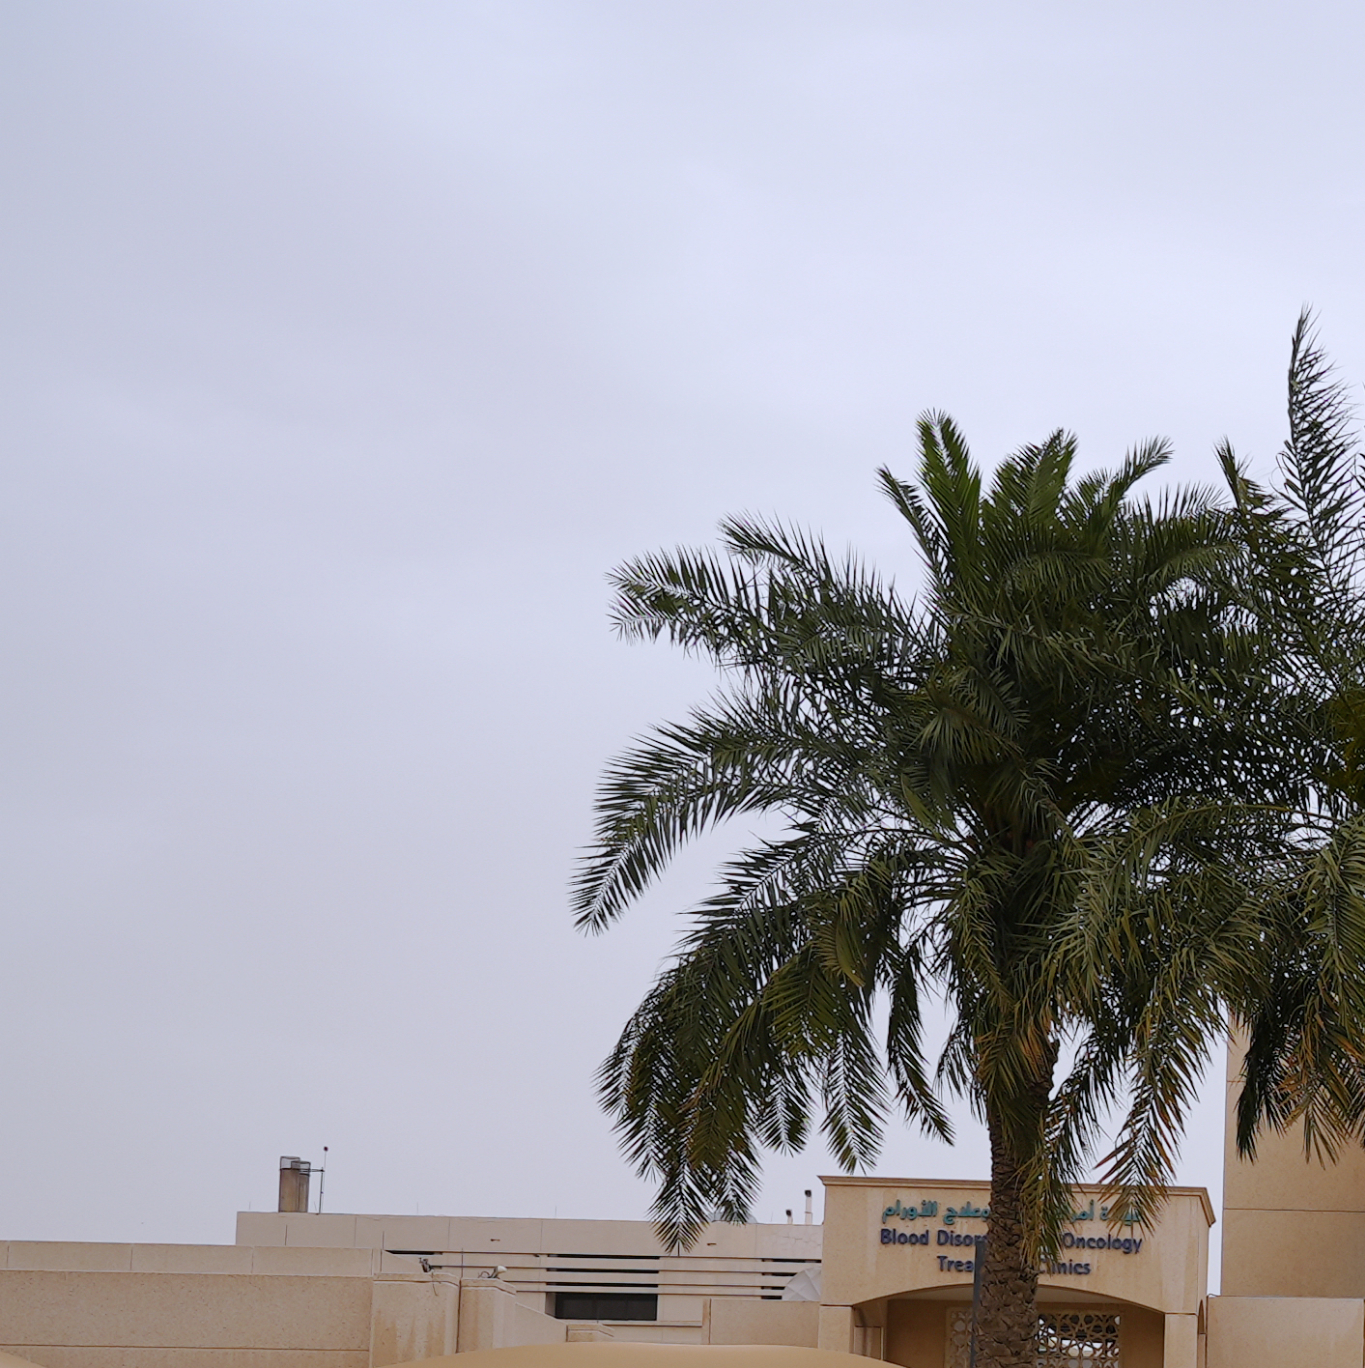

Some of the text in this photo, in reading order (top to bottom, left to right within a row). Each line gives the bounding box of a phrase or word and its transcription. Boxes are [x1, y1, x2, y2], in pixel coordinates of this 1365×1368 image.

[880, 1228, 1143, 1254] Blood Disor Oncology
